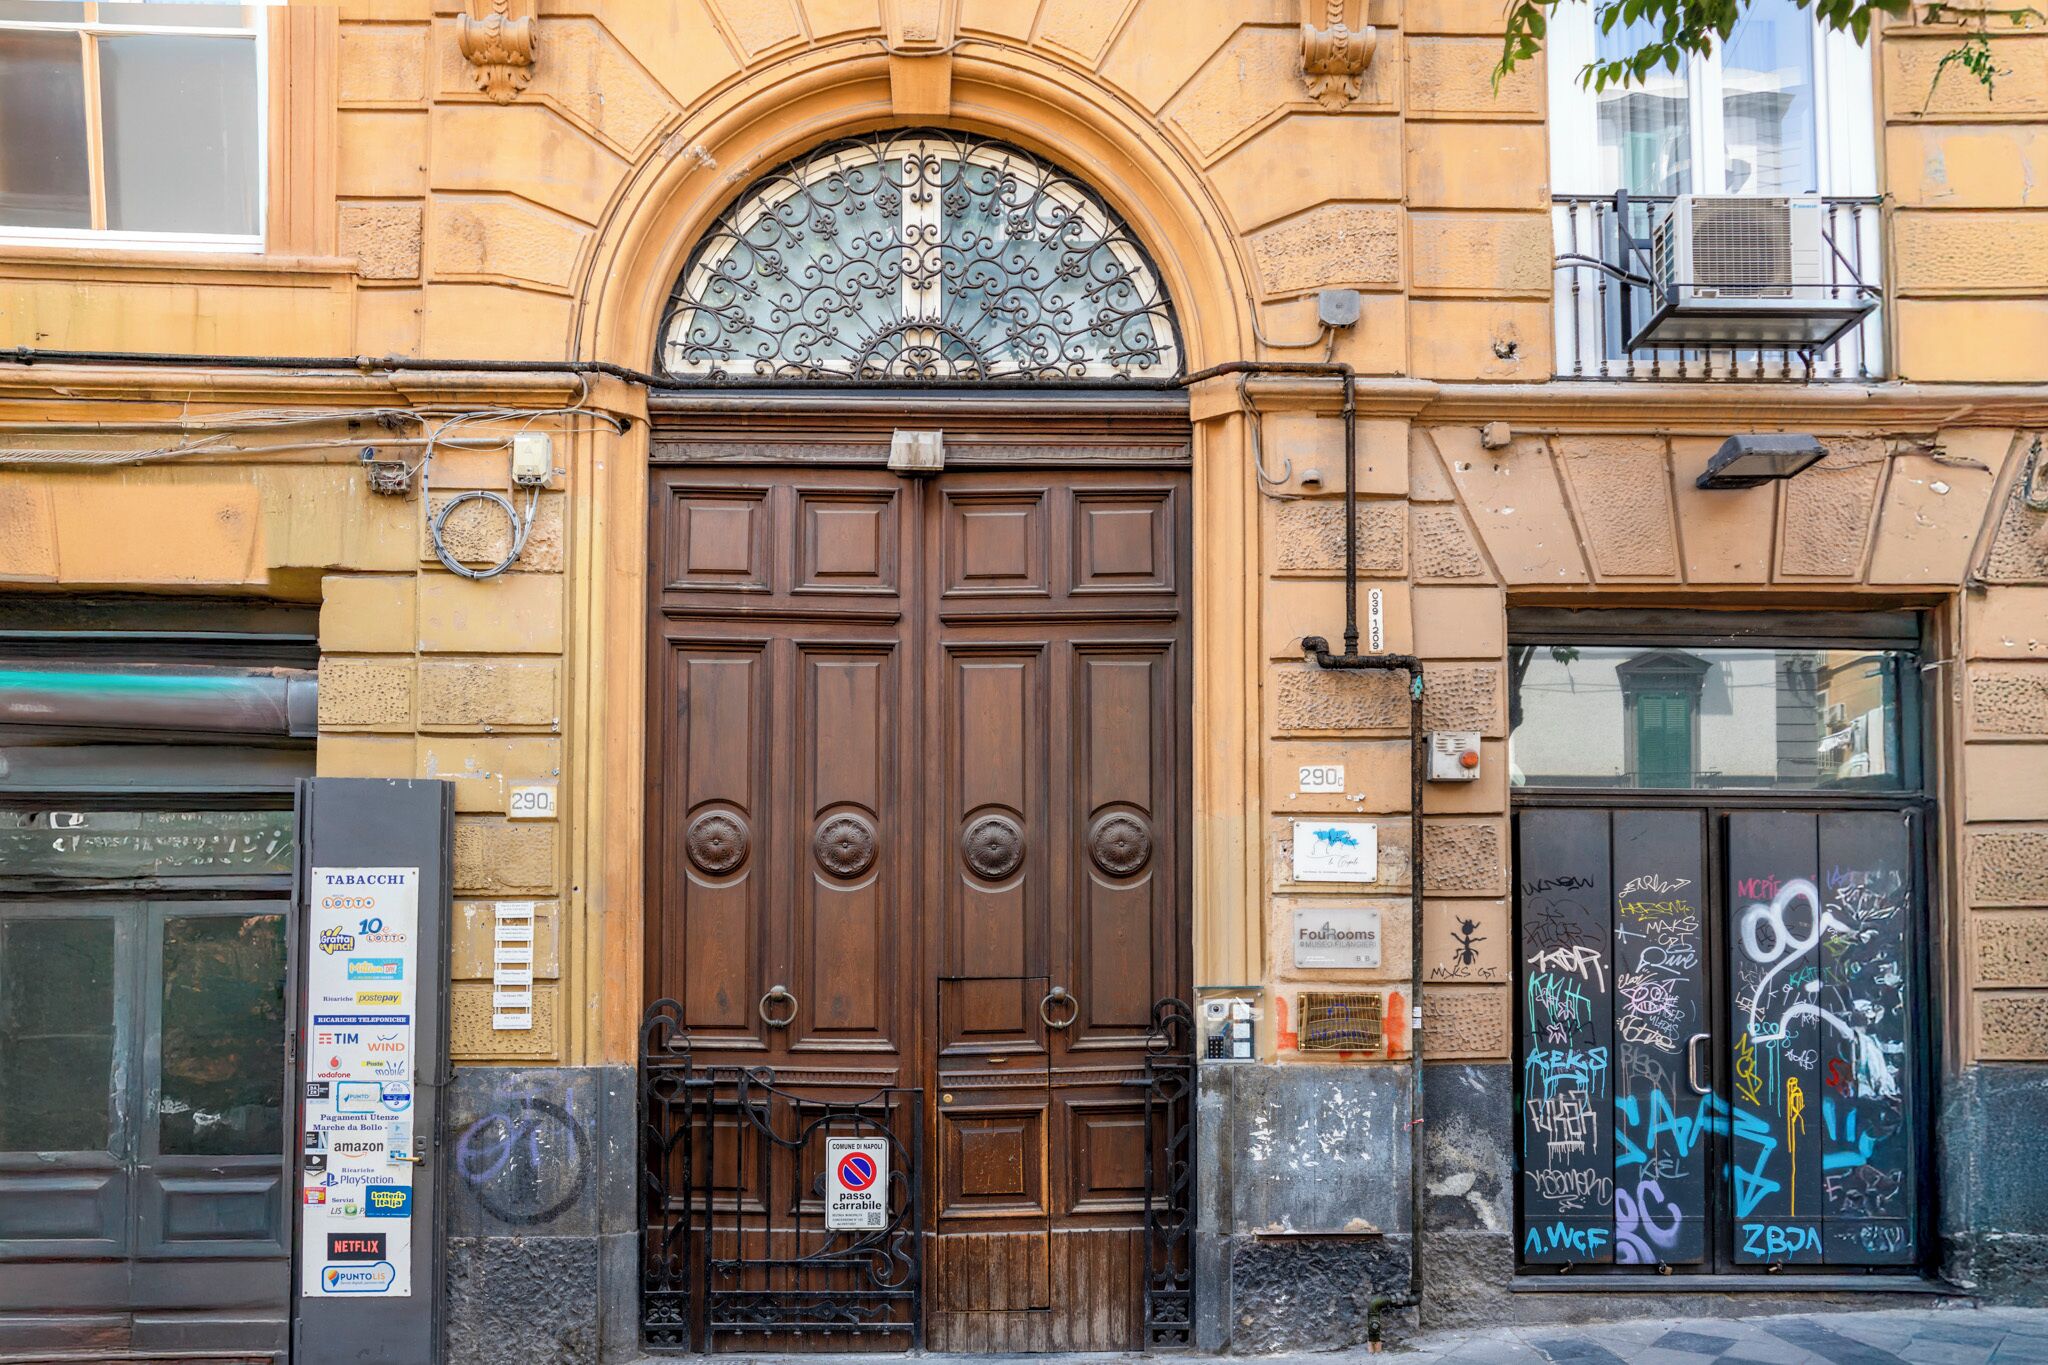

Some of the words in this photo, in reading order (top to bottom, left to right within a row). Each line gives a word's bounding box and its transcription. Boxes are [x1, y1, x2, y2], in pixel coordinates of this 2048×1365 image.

[1372, 619, 1380, 650] 1209
[325, 874, 405, 885] TABACCHI
[322, 896, 375, 910] LOTTO
[358, 917, 383, 935] 10
[320, 934, 350, 944] Gratta
[366, 933, 407, 943] LOTTO
[358, 993, 399, 1003] postepay
[334, 1033, 359, 1044] TIM
[367, 1042, 405, 1052] WIND
[318, 1071, 351, 1079] vodafone
[320, 1114, 367, 1122] Pagamenti
[334, 1142, 384, 1152] amazon
[340, 1175, 394, 1186] PlayStation
[372, 1192, 405, 1200] Lotteria
[839, 1192, 872, 1201] passo
[375, 1199, 402, 1207] Italia
[832, 1201, 882, 1210] carrabile
[334, 1241, 379, 1254] NETFLIX
